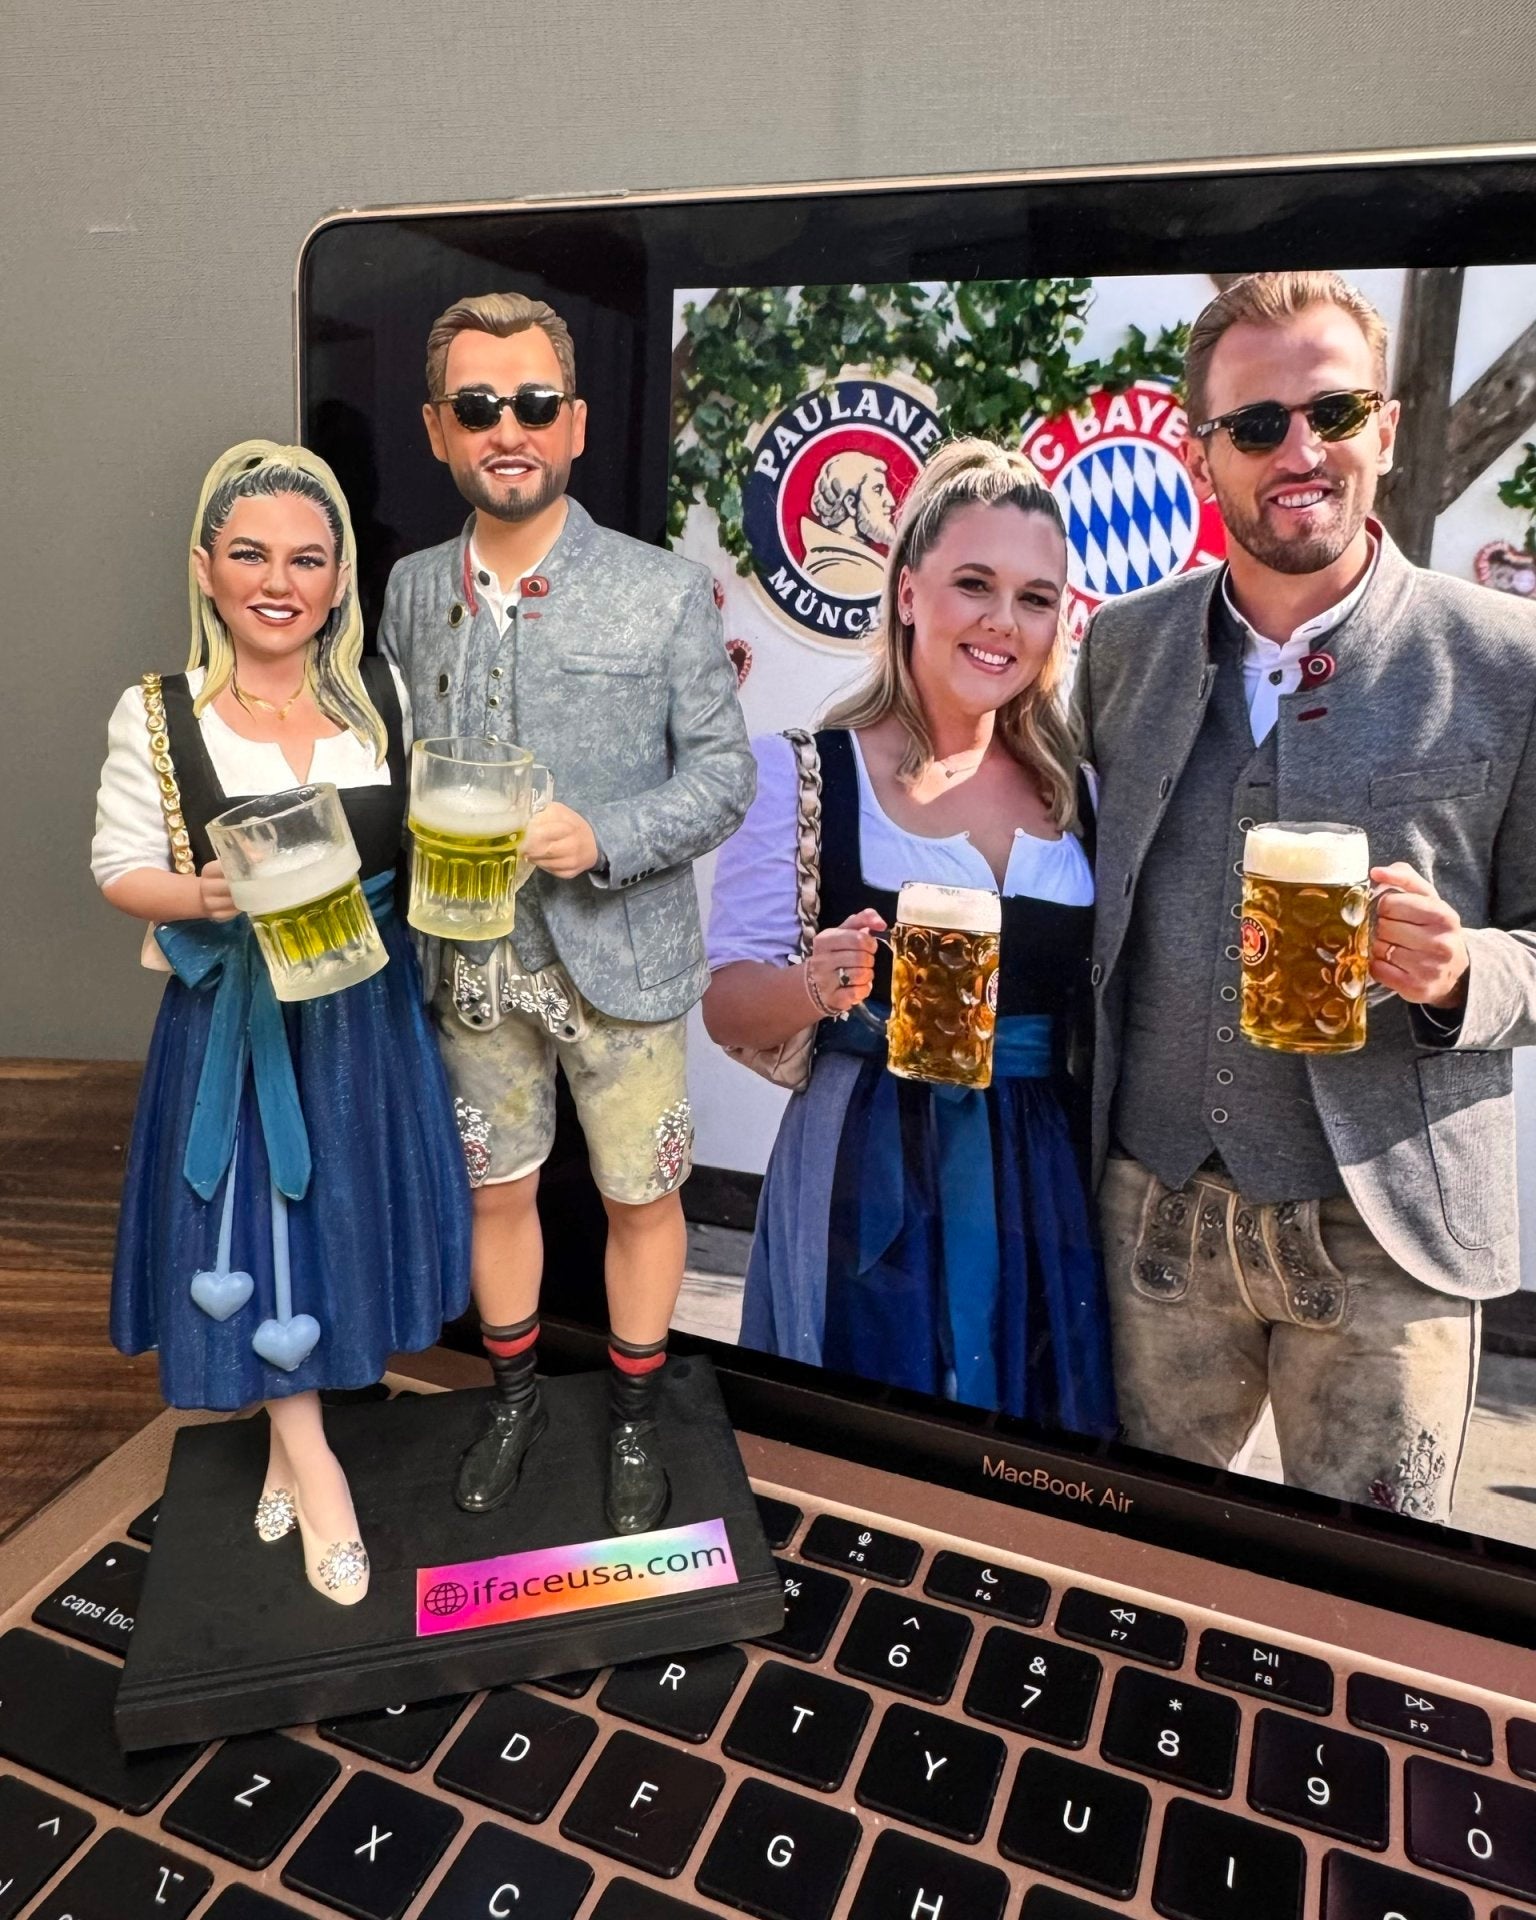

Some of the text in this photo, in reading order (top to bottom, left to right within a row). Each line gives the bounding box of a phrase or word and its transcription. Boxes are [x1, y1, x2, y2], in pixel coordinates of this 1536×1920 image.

[982, 1455, 1134, 1514] MacBook Air
[847, 1550, 866, 1562] F5
[473, 1546, 727, 1606] ifaceusa.com
[784, 1578, 803, 1597] %
[975, 1589, 992, 1602] F6
[61, 1594, 135, 1632] caps loc
[1110, 1629, 1128, 1641] F7
[888, 1644, 911, 1668] 6
[1028, 1656, 1047, 1677] &
[659, 1662, 687, 1691] R
[1254, 1672, 1273, 1686] F8
[1021, 1684, 1041, 1709] 7
[791, 1705, 814, 1734] T
[1409, 1719, 1430, 1733] F9
[500, 1732, 531, 1762] D
[1157, 1729, 1180, 1757] 8
[924, 1751, 947, 1781] Y
[234, 1774, 271, 1808] Z
[630, 1781, 659, 1809] F
[1307, 1777, 1330, 1806] 9
[1063, 1799, 1090, 1834] U
[354, 1824, 393, 1862] X
[766, 1834, 795, 1868] G
[1467, 1828, 1493, 1860] 0
[1227, 1856, 1235, 1889] I
[488, 1883, 520, 1919] C
[910, 1887, 944, 1920] H
